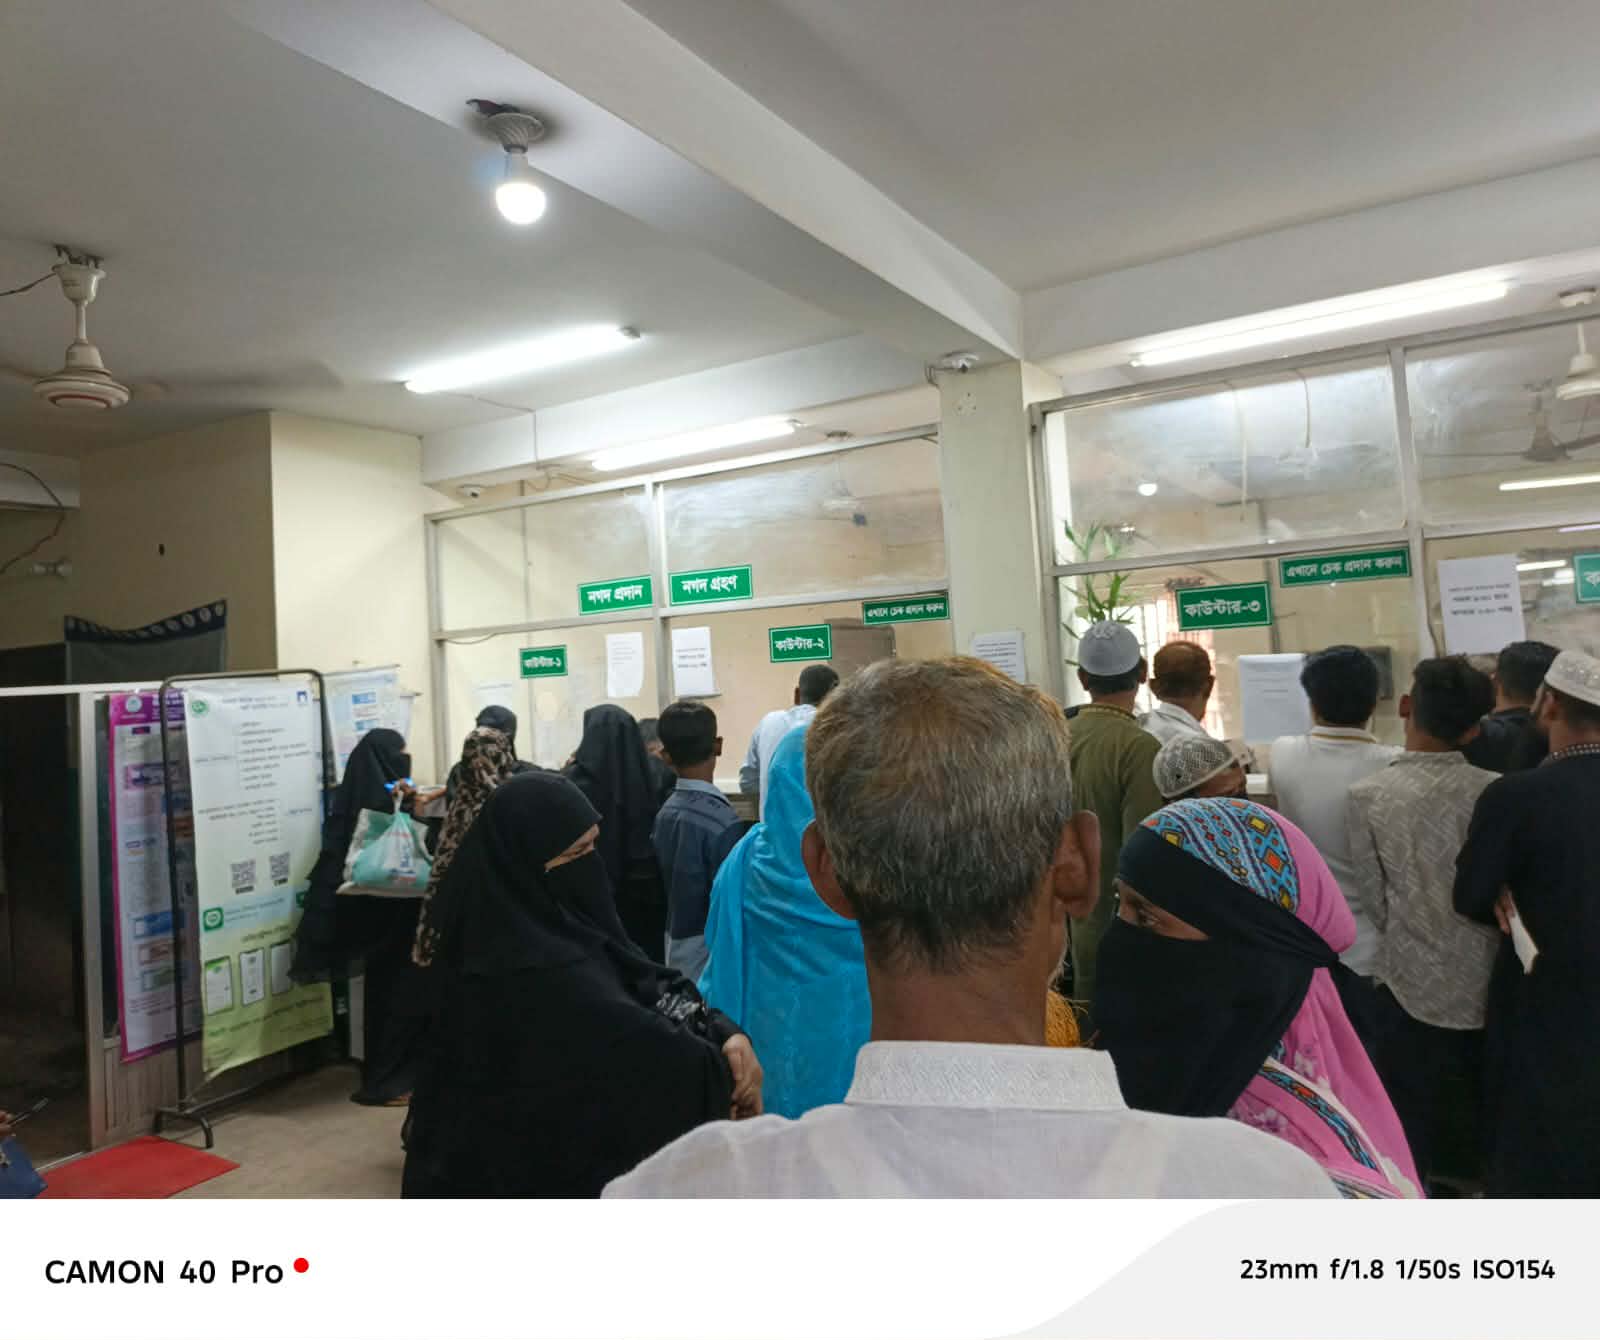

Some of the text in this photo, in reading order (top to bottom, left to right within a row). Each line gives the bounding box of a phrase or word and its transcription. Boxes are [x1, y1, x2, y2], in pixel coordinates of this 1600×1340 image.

[1321, 562, 1342, 576] চেক
[1344, 559, 1372, 573] প্রদান
[1375, 555, 1403, 569] করুন
[587, 584, 643, 604] নগদ প্রদান
[681, 574, 738, 595] নগদ গ্রহণ
[1183, 598, 1261, 618] কাউন্টার-৩
[775, 636, 824, 651] কাউন্টার-২
